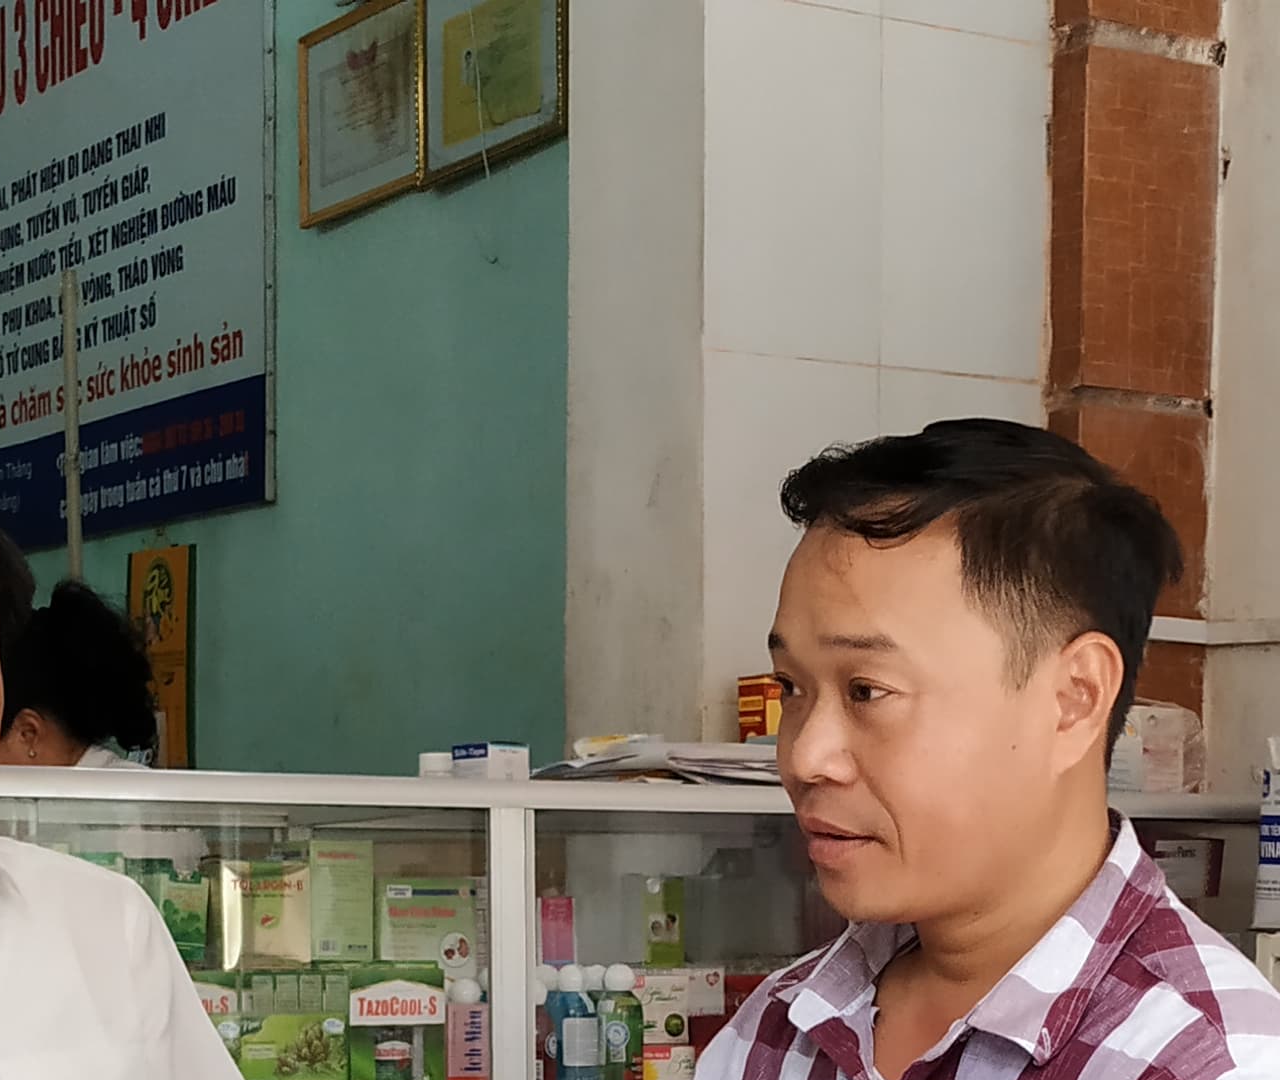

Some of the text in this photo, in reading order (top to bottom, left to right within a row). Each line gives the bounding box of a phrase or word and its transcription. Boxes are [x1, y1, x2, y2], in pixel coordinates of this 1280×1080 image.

[14, 0, 27, 105] 3
[11, 174, 37, 207] PHÁT
[40, 162, 65, 194] HIỆN
[115, 124, 142, 157] THAI
[144, 112, 166, 145] NHI
[88, 220, 108, 261] XÉT
[111, 206, 158, 251] NGHIỆM
[206, 174, 237, 212] MÁU
[10, 384, 51, 425] chăm
[56, 384, 83, 413] sc
[87, 366, 115, 399] sức
[167, 337, 204, 378] sinh
[210, 320, 244, 364] sản
[21, 336, 50, 370] CUNG
[52, 323, 81, 361] BẰG
[80, 487, 99, 516] gày
